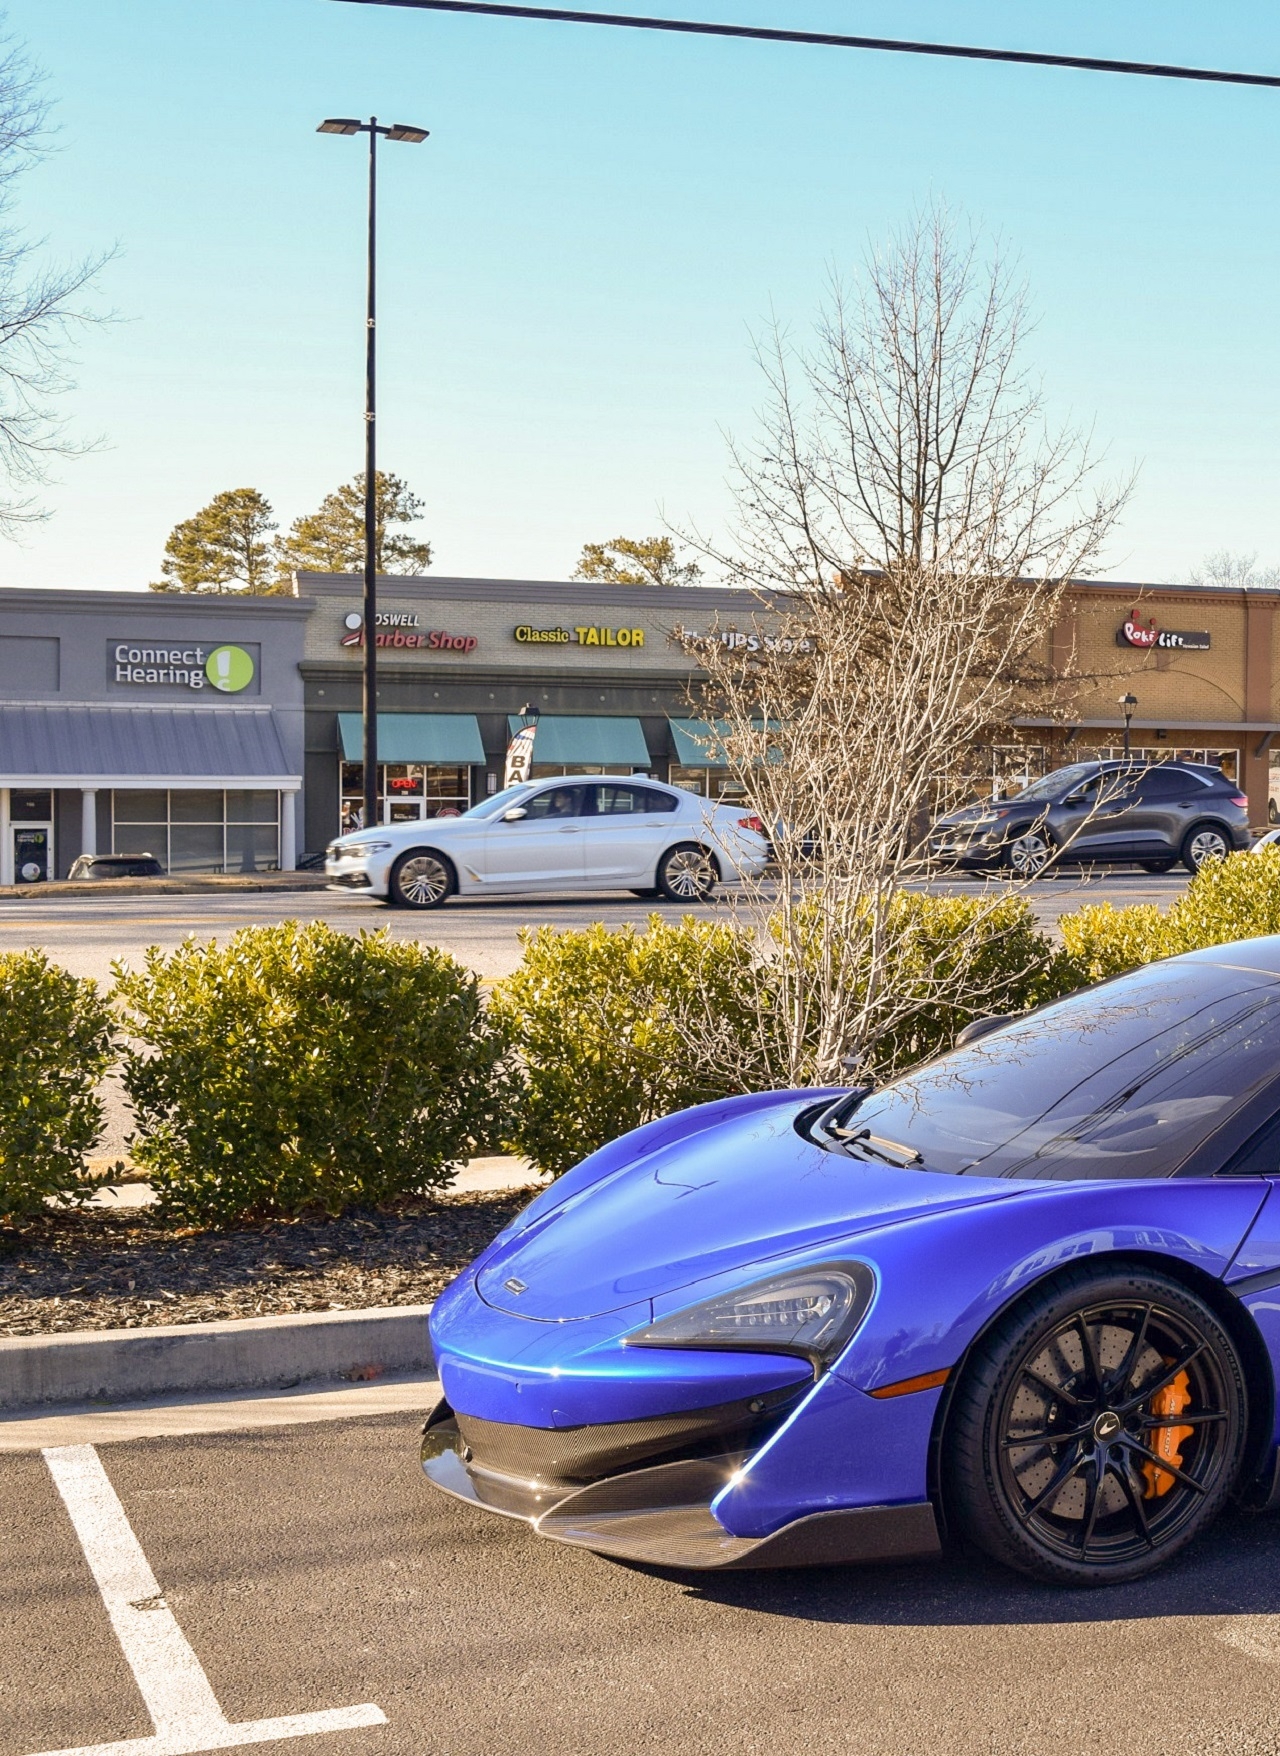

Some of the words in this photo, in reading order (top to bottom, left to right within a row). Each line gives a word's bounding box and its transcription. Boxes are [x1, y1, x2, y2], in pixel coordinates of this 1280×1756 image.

[374, 613, 420, 627] OSWELL
[429, 630, 478, 654] Shop
[515, 626, 570, 643] Classic
[574, 627, 645, 647] TAILOR
[115, 645, 204, 665] Connect
[115, 664, 204, 689] Hearing
[391, 778, 417, 789] OPEN
